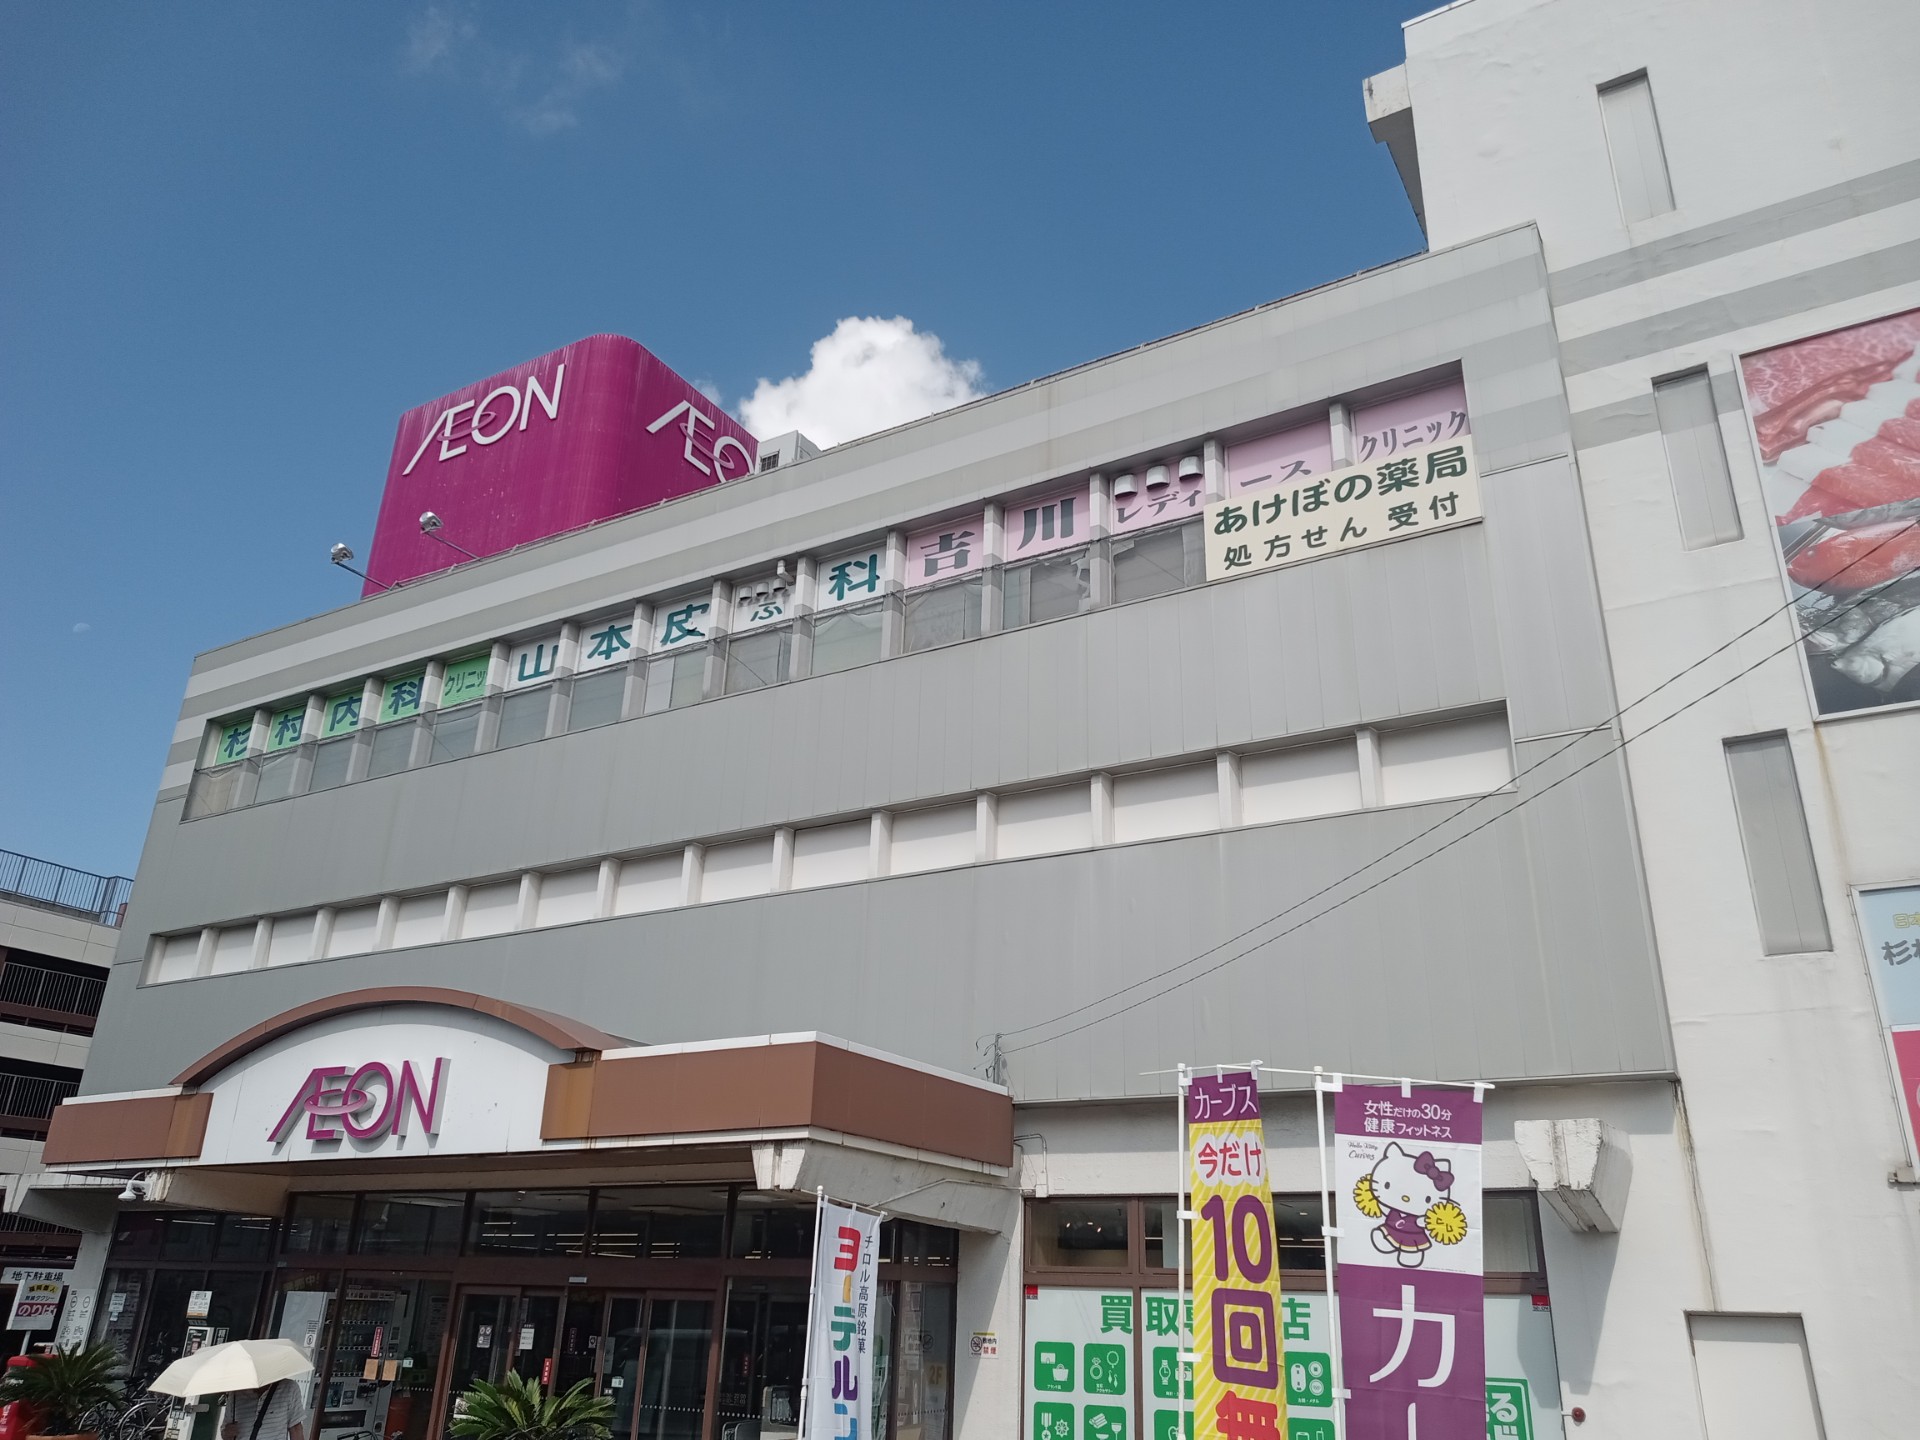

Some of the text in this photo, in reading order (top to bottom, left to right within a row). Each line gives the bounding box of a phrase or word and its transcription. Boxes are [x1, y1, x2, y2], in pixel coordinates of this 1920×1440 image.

[1214, 445, 1468, 535] あけぼの薬局
[1195, 1084, 1258, 1119] カーブス
[1364, 1100, 1453, 1121] 女性だけの30分
[1199, 1141, 1262, 1178] 今だけ
[11, 1271, 64, 1281] 地下駐車場
[18, 1304, 57, 1317] のりば
[857, 1235, 873, 1353] チロル高原銘菓
